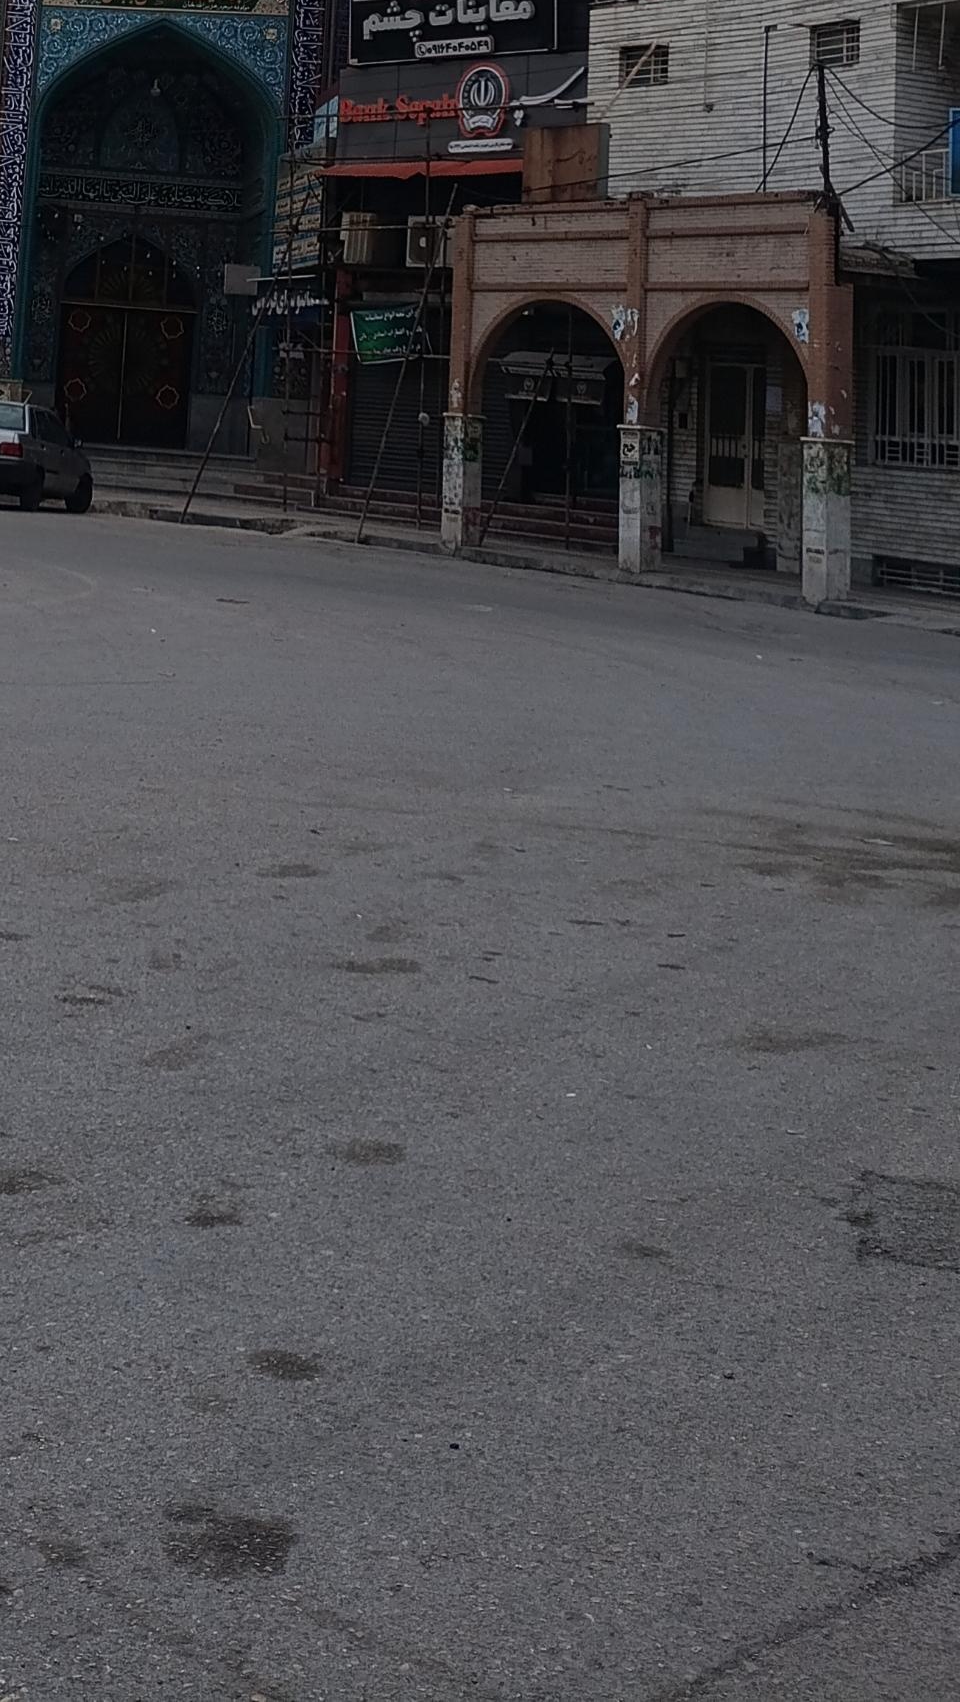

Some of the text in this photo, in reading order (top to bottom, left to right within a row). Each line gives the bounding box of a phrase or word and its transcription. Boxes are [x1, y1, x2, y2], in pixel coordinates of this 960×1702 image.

[363, 0, 425, 42] چشم
[340, 93, 460, 126] Bank Sepah
